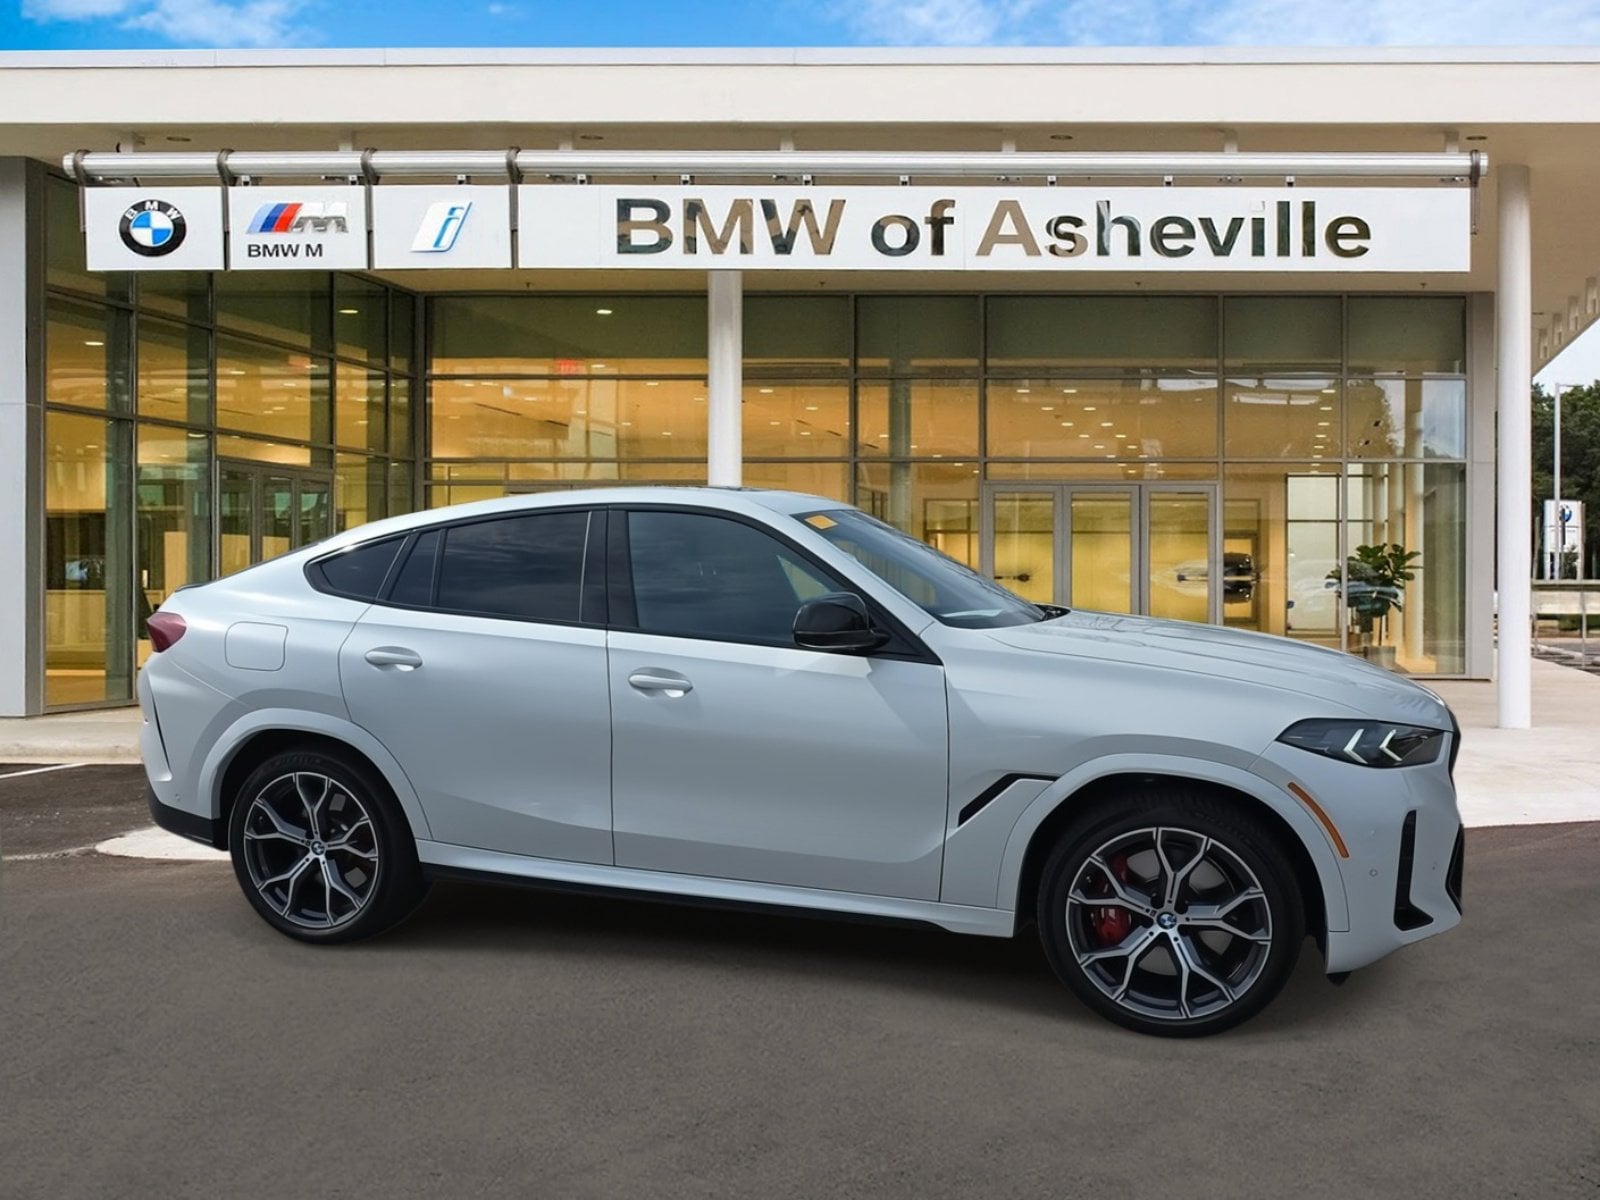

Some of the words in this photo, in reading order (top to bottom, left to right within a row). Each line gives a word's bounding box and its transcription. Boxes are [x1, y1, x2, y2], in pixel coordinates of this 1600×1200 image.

[125, 200, 181, 220] BMW
[615, 198, 846, 255] BMW
[870, 198, 956, 257] of
[975, 199, 1372, 258] Asheville
[247, 243, 300, 258] BMW
[305, 243, 323, 258] M
